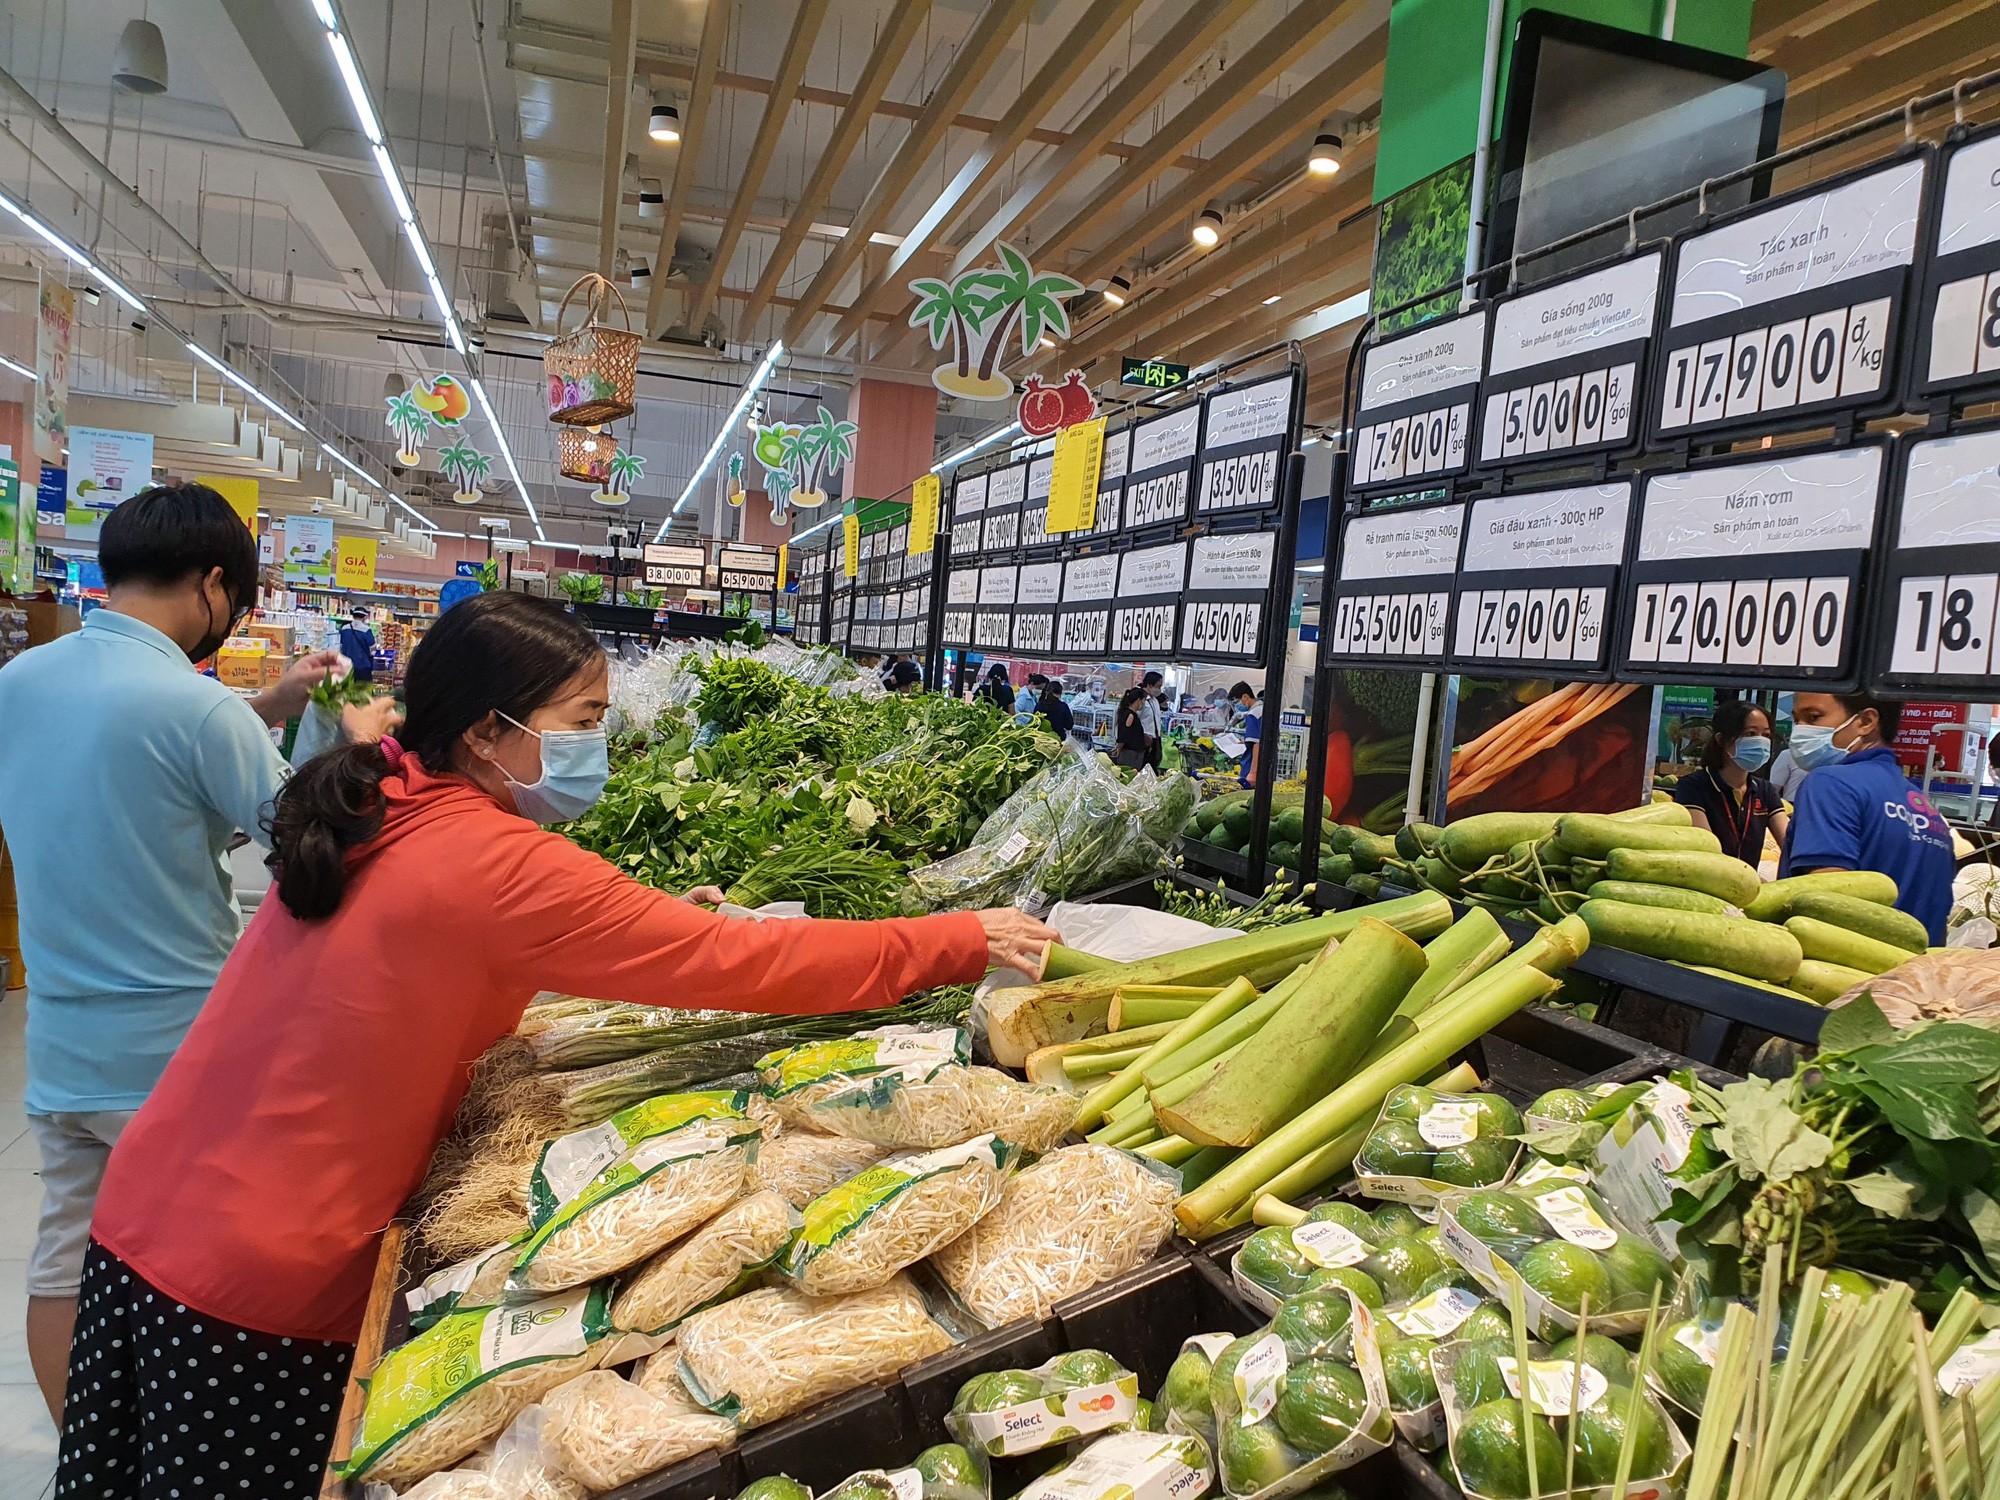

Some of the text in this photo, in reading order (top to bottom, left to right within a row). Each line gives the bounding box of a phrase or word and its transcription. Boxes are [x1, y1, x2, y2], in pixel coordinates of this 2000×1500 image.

[1760, 224, 1829, 258] Tắc xanh
[1745, 272, 1763, 284] Sản
[1765, 262, 1794, 281] phẩm
[1813, 251, 1836, 266] toàn
[1560, 300, 1585, 317] sống
[1588, 292, 1613, 310] 200g
[1521, 339, 1532, 349] Sản
[1534, 331, 1551, 347] phẩm
[1564, 324, 1577, 336] tiêu
[1578, 317, 1599, 332] chuẩn
[1601, 308, 1631, 325] VietGAP
[1414, 348, 1432, 364] xanh
[1434, 342, 1454, 357] 200g
[1129, 367, 1145, 378] EXIT
[1674, 327, 1835, 409] 17.900
[1505, 383, 1600, 443] 5.000
[1373, 417, 1442, 470] 7.900
[1213, 462, 1259, 499] 3.500
[1136, 480, 1174, 517] 5.700
[1725, 490, 1793, 510] Nấm rơm
[1490, 521, 1505, 535] Giá
[1507, 518, 1525, 535] đậu
[1527, 515, 1551, 530] xanh
[1560, 510, 1587, 526] 300g
[1588, 506, 1604, 521] HP
[1713, 515, 1799, 534] Sản phẩm an toàn
[1376, 532, 1394, 544] tranh
[1395, 529, 1410, 542] mía
[1439, 525, 1458, 539] 500g
[1512, 536, 1573, 550] Sản phẩm an toàn
[345, 556, 368, 567] GIÁ
[357, 568, 370, 576] Hot
[648, 568, 690, 580] 38.000
[723, 575, 764, 586] 65.900
[1020, 618, 1044, 641] 5.500
[1066, 616, 1096, 643] 4.500
[1123, 612, 1161, 642] 3.500
[1195, 610, 1241, 644] 6.500
[1339, 603, 1422, 642] 15.500
[1479, 597, 1570, 645] 7.900
[1644, 590, 1838, 648] 120.000
[1906, 709, 1921, 717] VND
[1933, 708, 1953, 718] ĐIỂM
[1912, 736, 1929, 745] ĐIỂM
[1672, 1104, 1695, 1137] Selec
[1370, 1184, 1405, 1192] Select
[1301, 1227, 1331, 1243] Select
[1445, 1228, 1474, 1260] Select
[1244, 1346, 1273, 1371] Select
[1006, 1413, 1042, 1432] Select
[1169, 1468, 1201, 1498] Select
